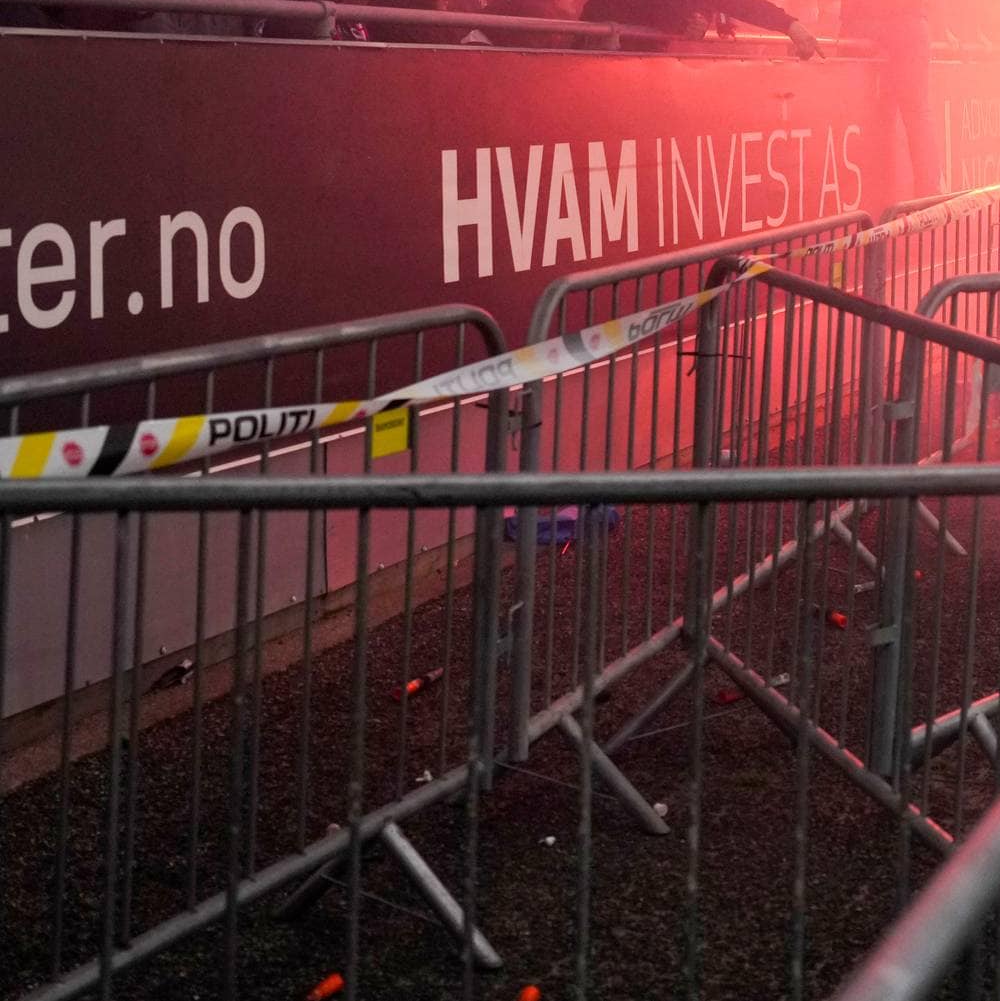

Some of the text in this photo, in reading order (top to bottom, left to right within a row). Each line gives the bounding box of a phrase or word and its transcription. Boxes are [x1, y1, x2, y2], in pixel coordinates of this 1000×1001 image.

[441, 125, 862, 284] HVAM INVEST AS
[208, 408, 316, 447] POLITI
